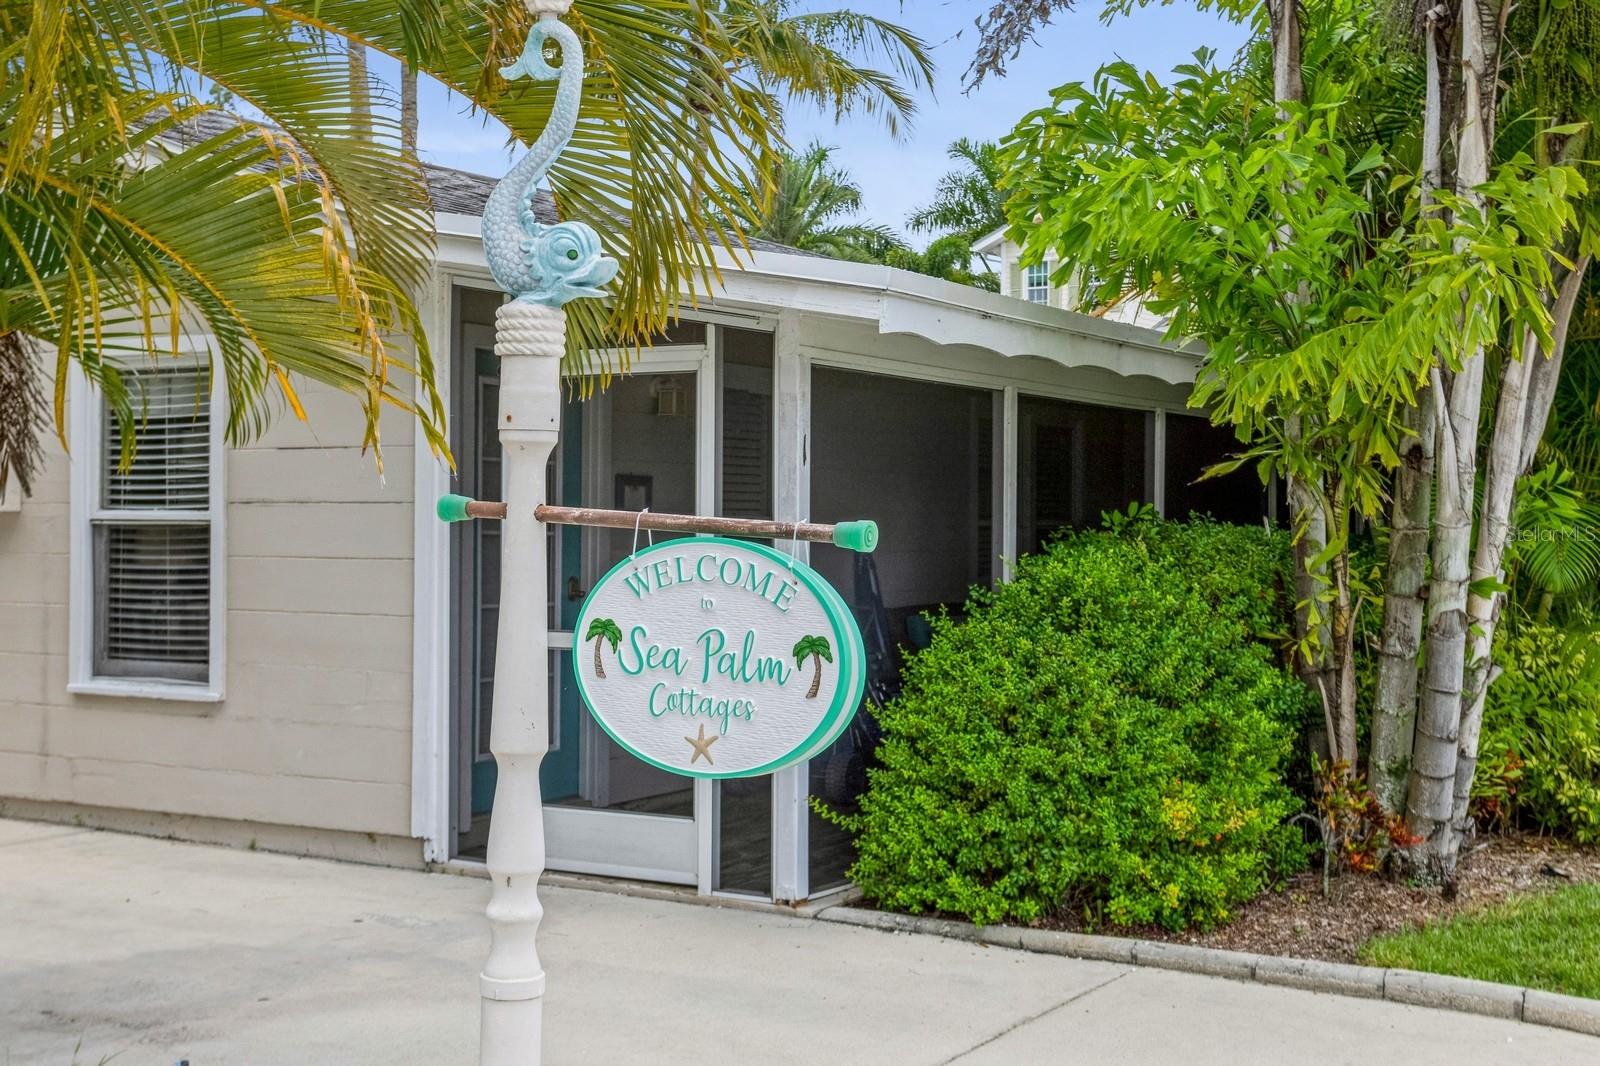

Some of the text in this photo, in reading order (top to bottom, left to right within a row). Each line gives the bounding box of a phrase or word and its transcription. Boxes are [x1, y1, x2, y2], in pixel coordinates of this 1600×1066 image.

[622, 553, 798, 613] WELCOME
[700, 596, 714, 609] to
[617, 625, 791, 686] Sea Palm
[649, 682, 755, 735] Cottages
